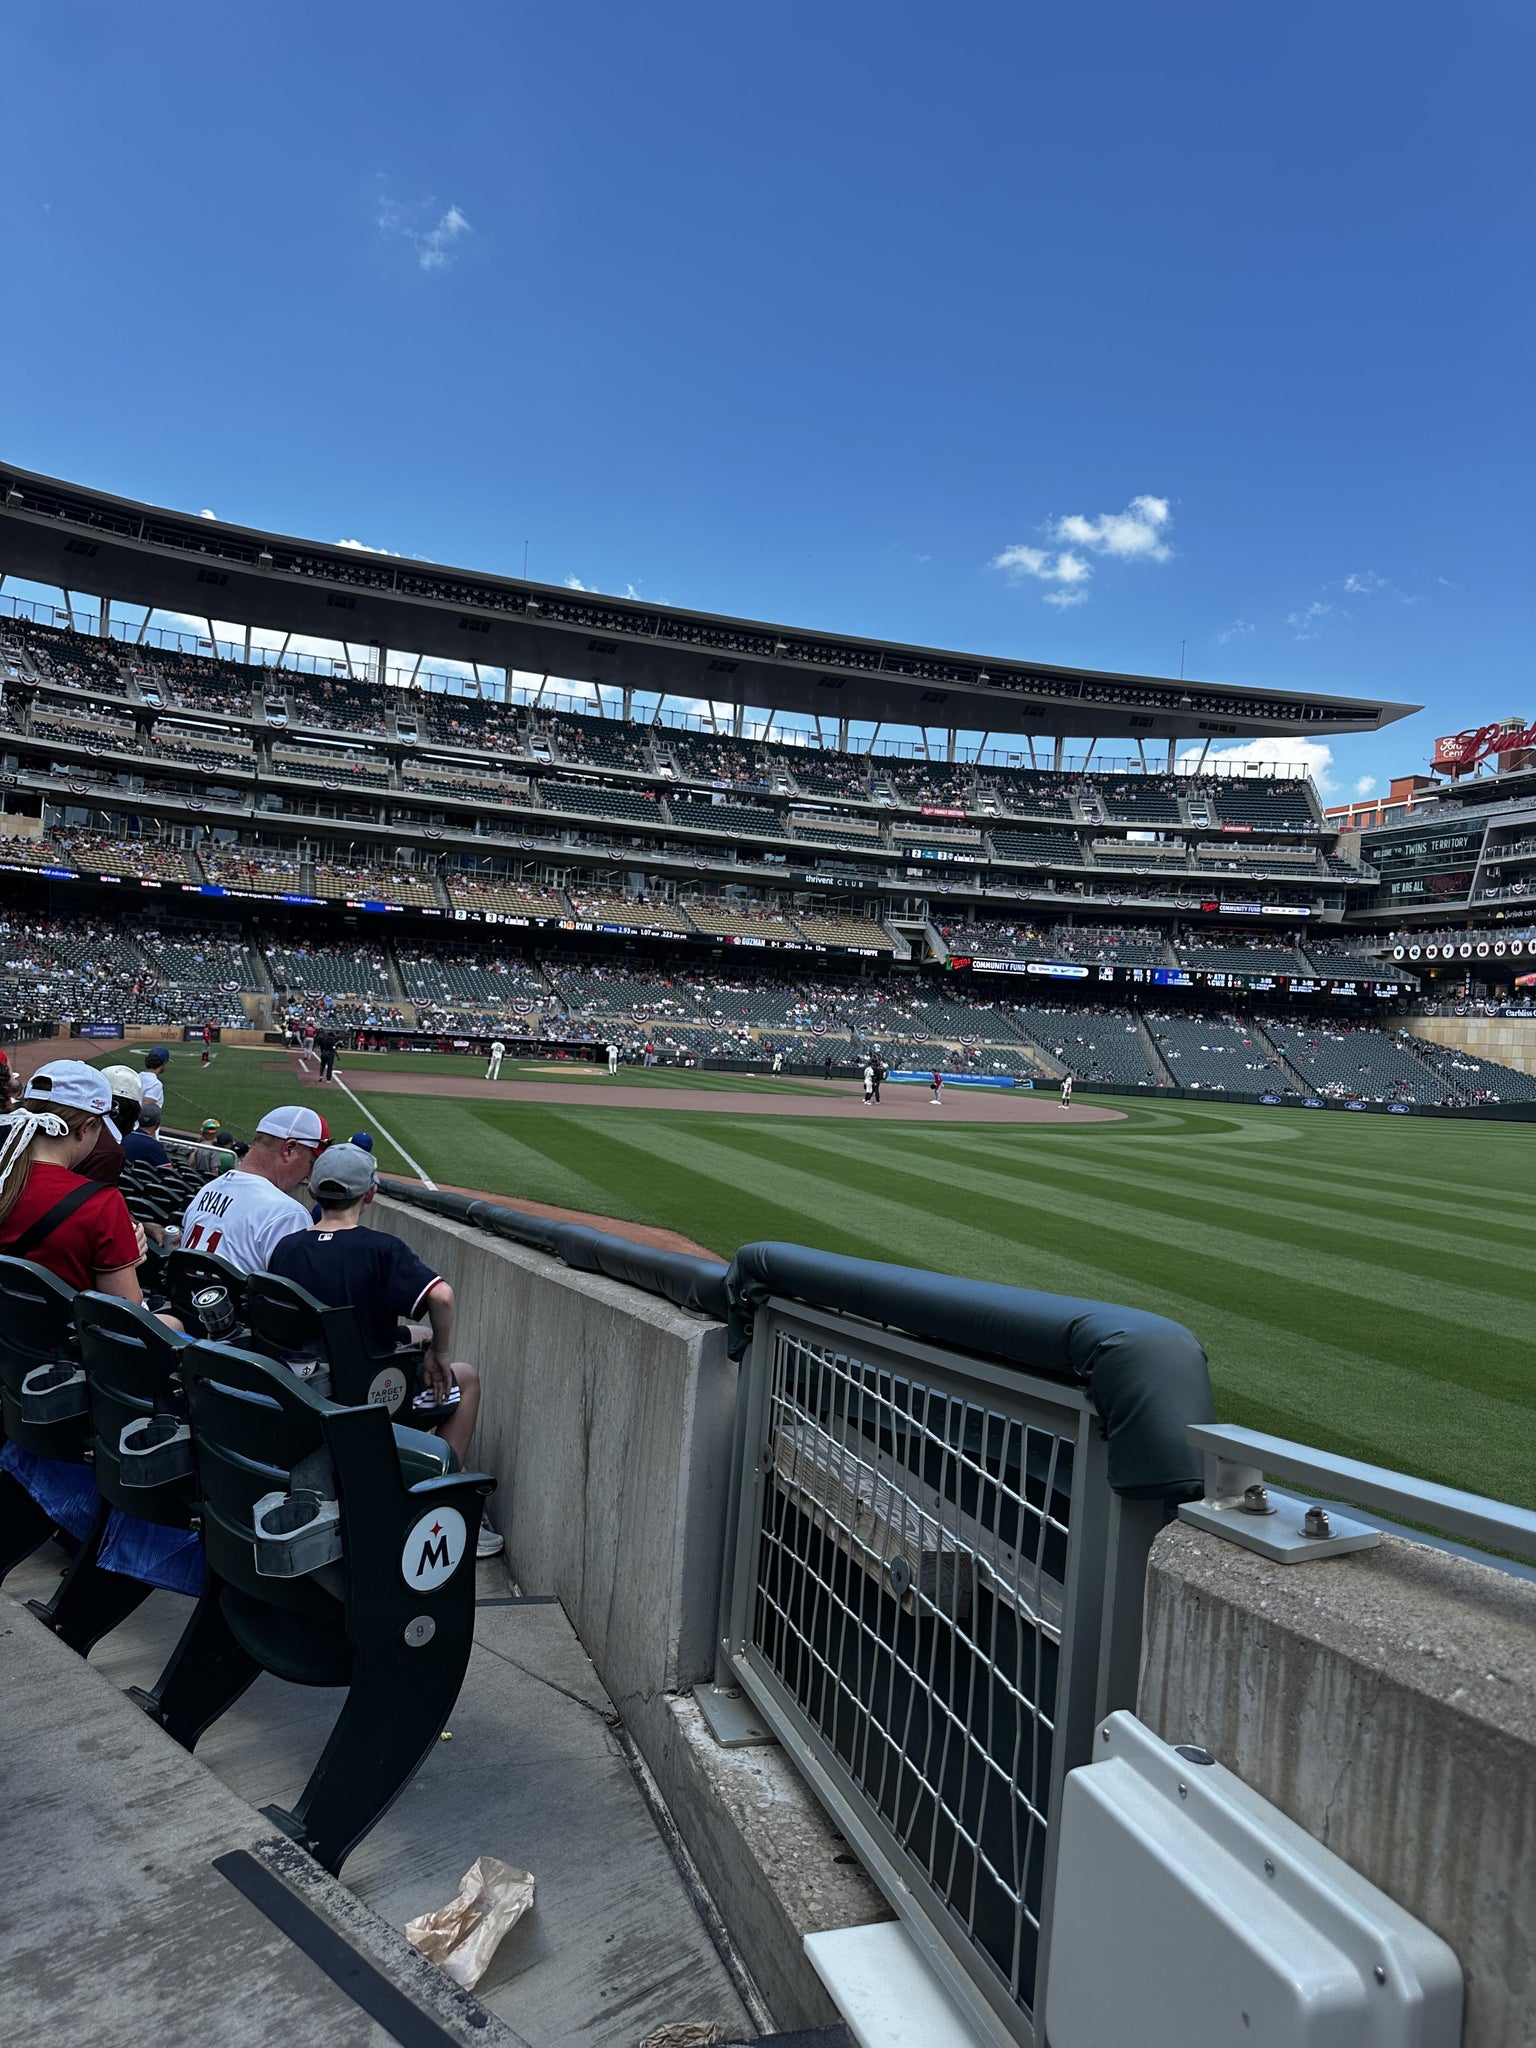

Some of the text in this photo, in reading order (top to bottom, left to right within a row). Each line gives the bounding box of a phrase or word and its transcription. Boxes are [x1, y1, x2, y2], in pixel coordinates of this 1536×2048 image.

[1373, 848, 1393, 858] WELCOME
[1405, 842, 1427, 856] TWINS
[1431, 837, 1469, 851] TERRITORY
[805, 874, 864, 888] thrivent CLUB
[1391, 880, 1424, 894] WE ARE ALL
[1219, 904, 1248, 912] COMMUNITY
[559, 920, 567, 929] 41
[575, 922, 593, 931] RYAN
[618, 926, 631, 934] 2.93
[741, 936, 766, 947] GUZMAN
[949, 956, 971, 970] Twins
[972, 960, 1009, 971] COMMUNITY
[1009, 962, 1026, 972] FUND
[1211, 979, 1226, 987] CWS
[1505, 1009, 1533, 1017] Carbliss
[196, 1191, 234, 1218] RYAN
[371, 1385, 404, 1400] TARGET
[374, 1392, 400, 1405] FIELD
[415, 1534, 451, 1577] M
[416, 1626, 424, 1637] 9
